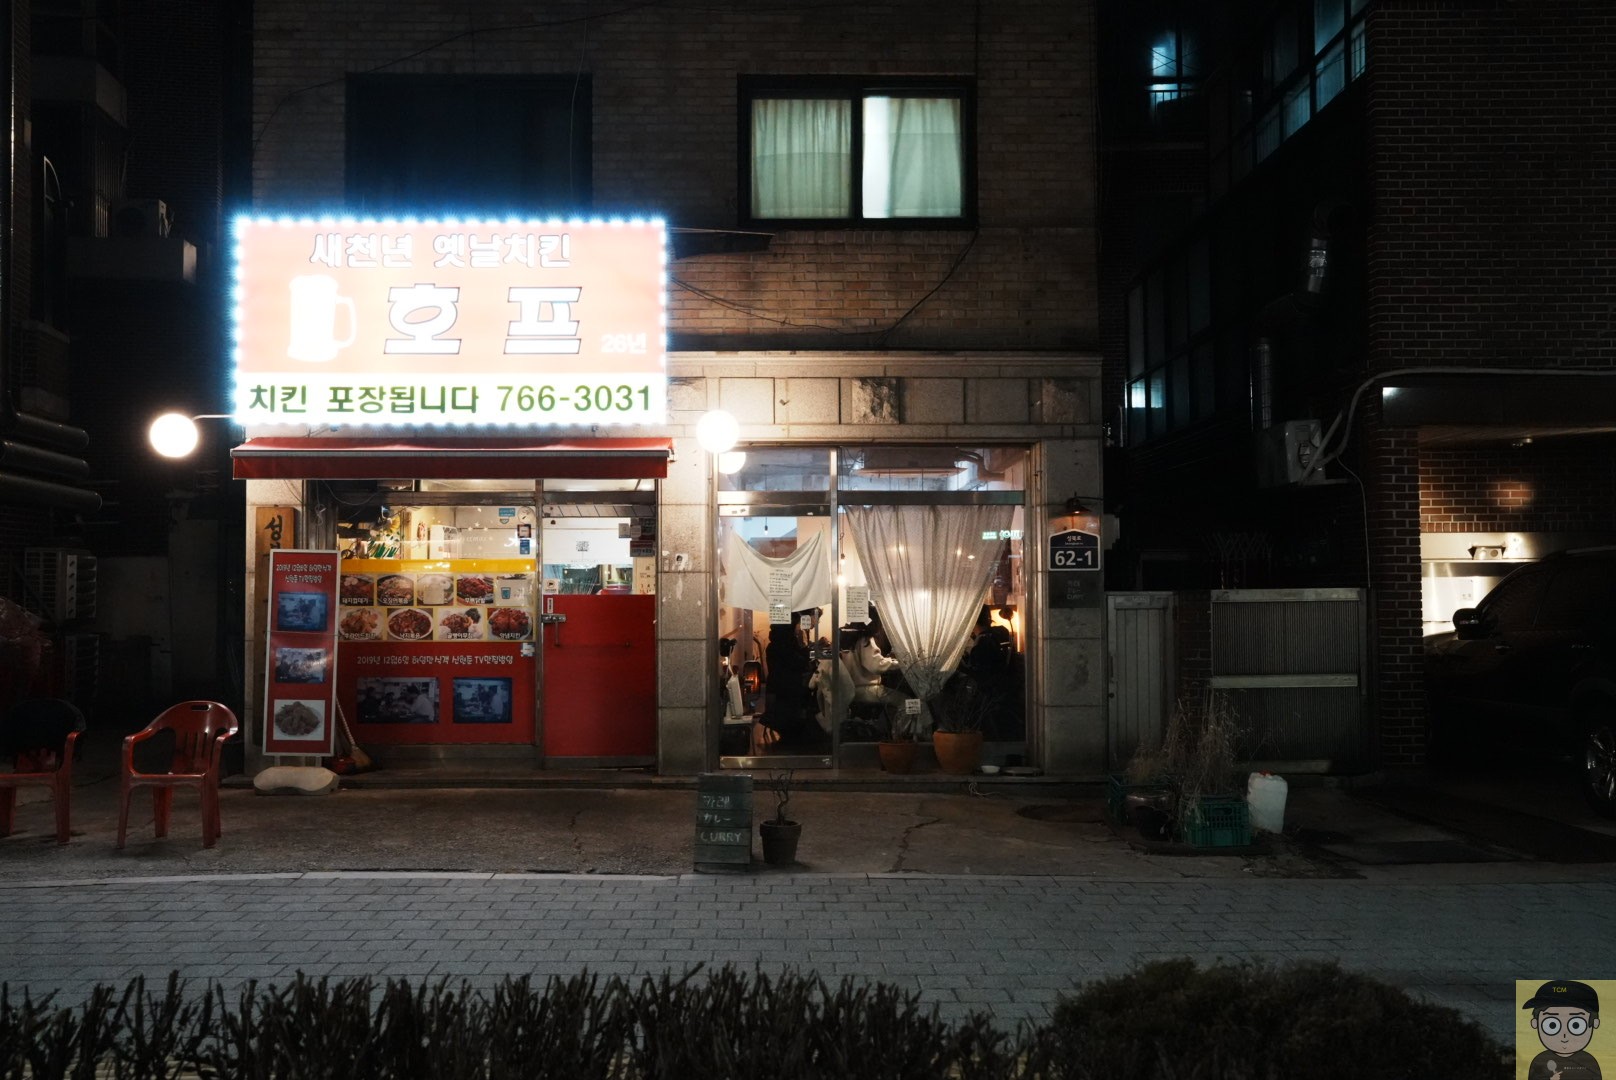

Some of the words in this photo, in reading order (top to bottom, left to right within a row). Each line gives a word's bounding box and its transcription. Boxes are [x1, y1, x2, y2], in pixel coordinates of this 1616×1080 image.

[310, 233, 414, 268] 새천년
[433, 233, 572, 268] 옛날치킨
[248, 385, 307, 413] 치킨
[326, 385, 479, 414] 포장됩니다
[496, 384, 650, 412] 766-3031
[1055, 550, 1092, 566] 62-1
[357, 655, 381, 665] 2019년
[700, 831, 742, 843] CURRY
